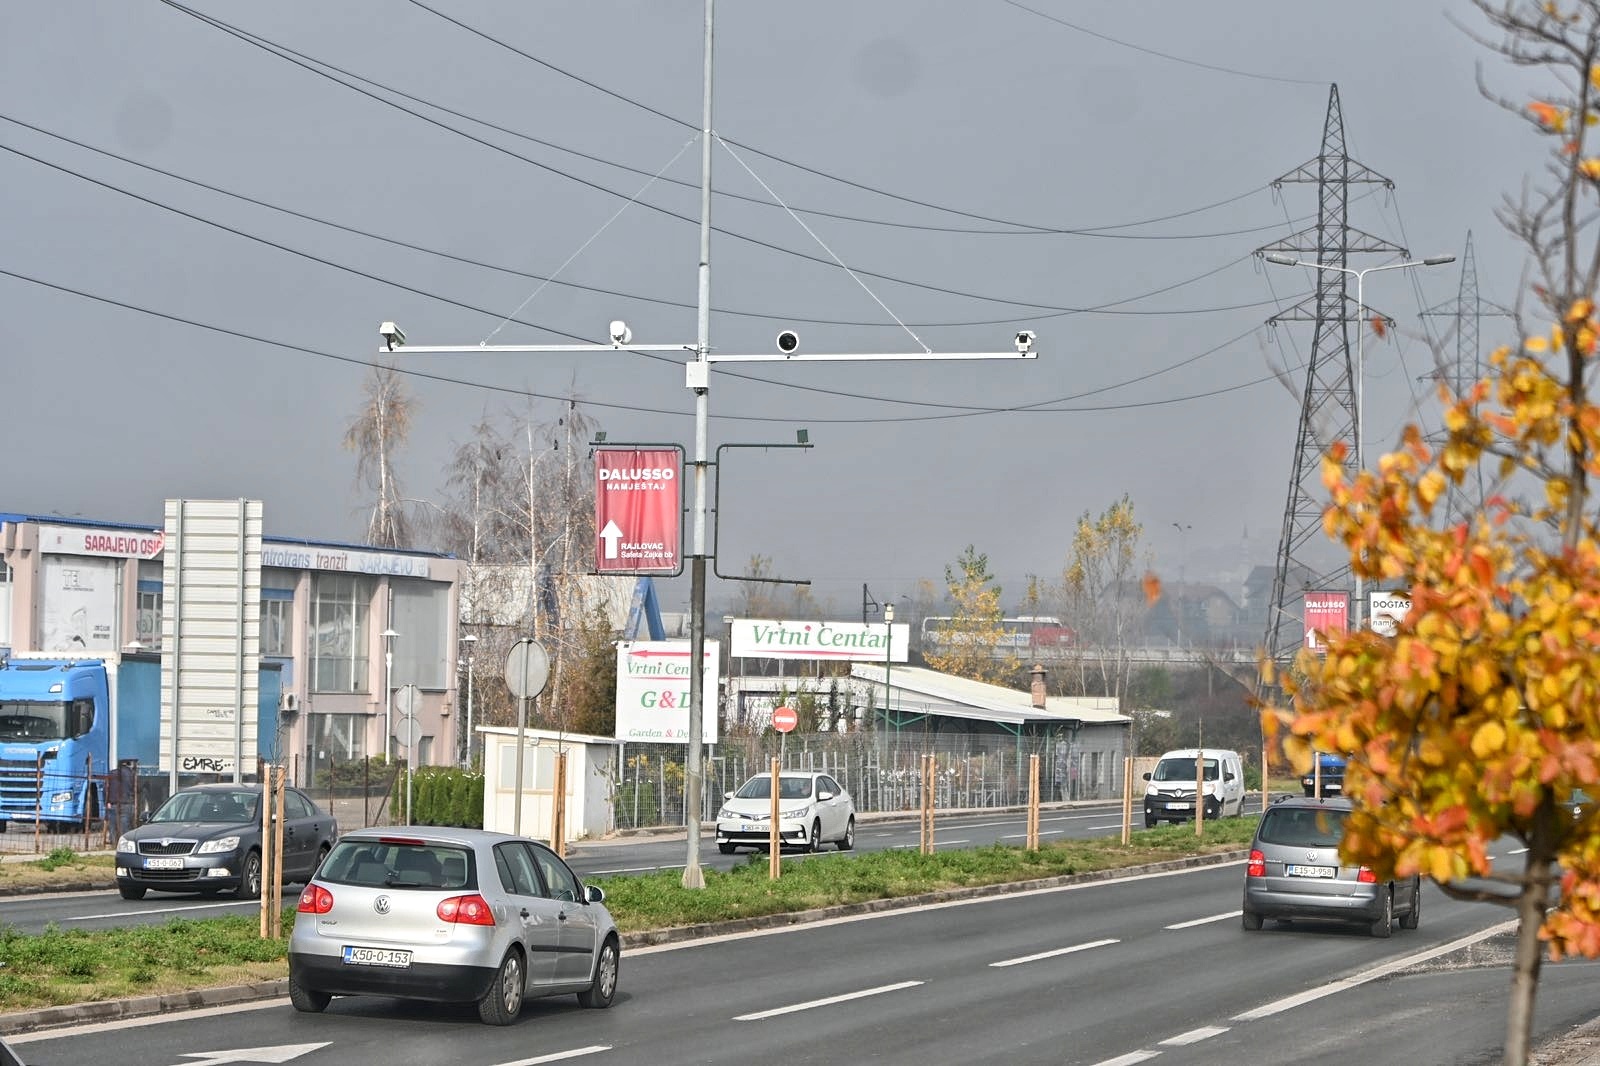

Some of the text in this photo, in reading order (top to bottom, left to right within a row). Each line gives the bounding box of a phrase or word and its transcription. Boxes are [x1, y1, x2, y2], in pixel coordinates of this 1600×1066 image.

[599, 468, 674, 480] DALUSSO
[85, 534, 137, 553] SARAJEVO
[262, 549, 310, 568] ntrotrans
[317, 552, 347, 570] tranzit
[753, 625, 893, 648] Vrtni Centar
[628, 662, 710, 675] Vrtni Cenr
[629, 728, 662, 737] Garden
[665, 729, 673, 737] &
